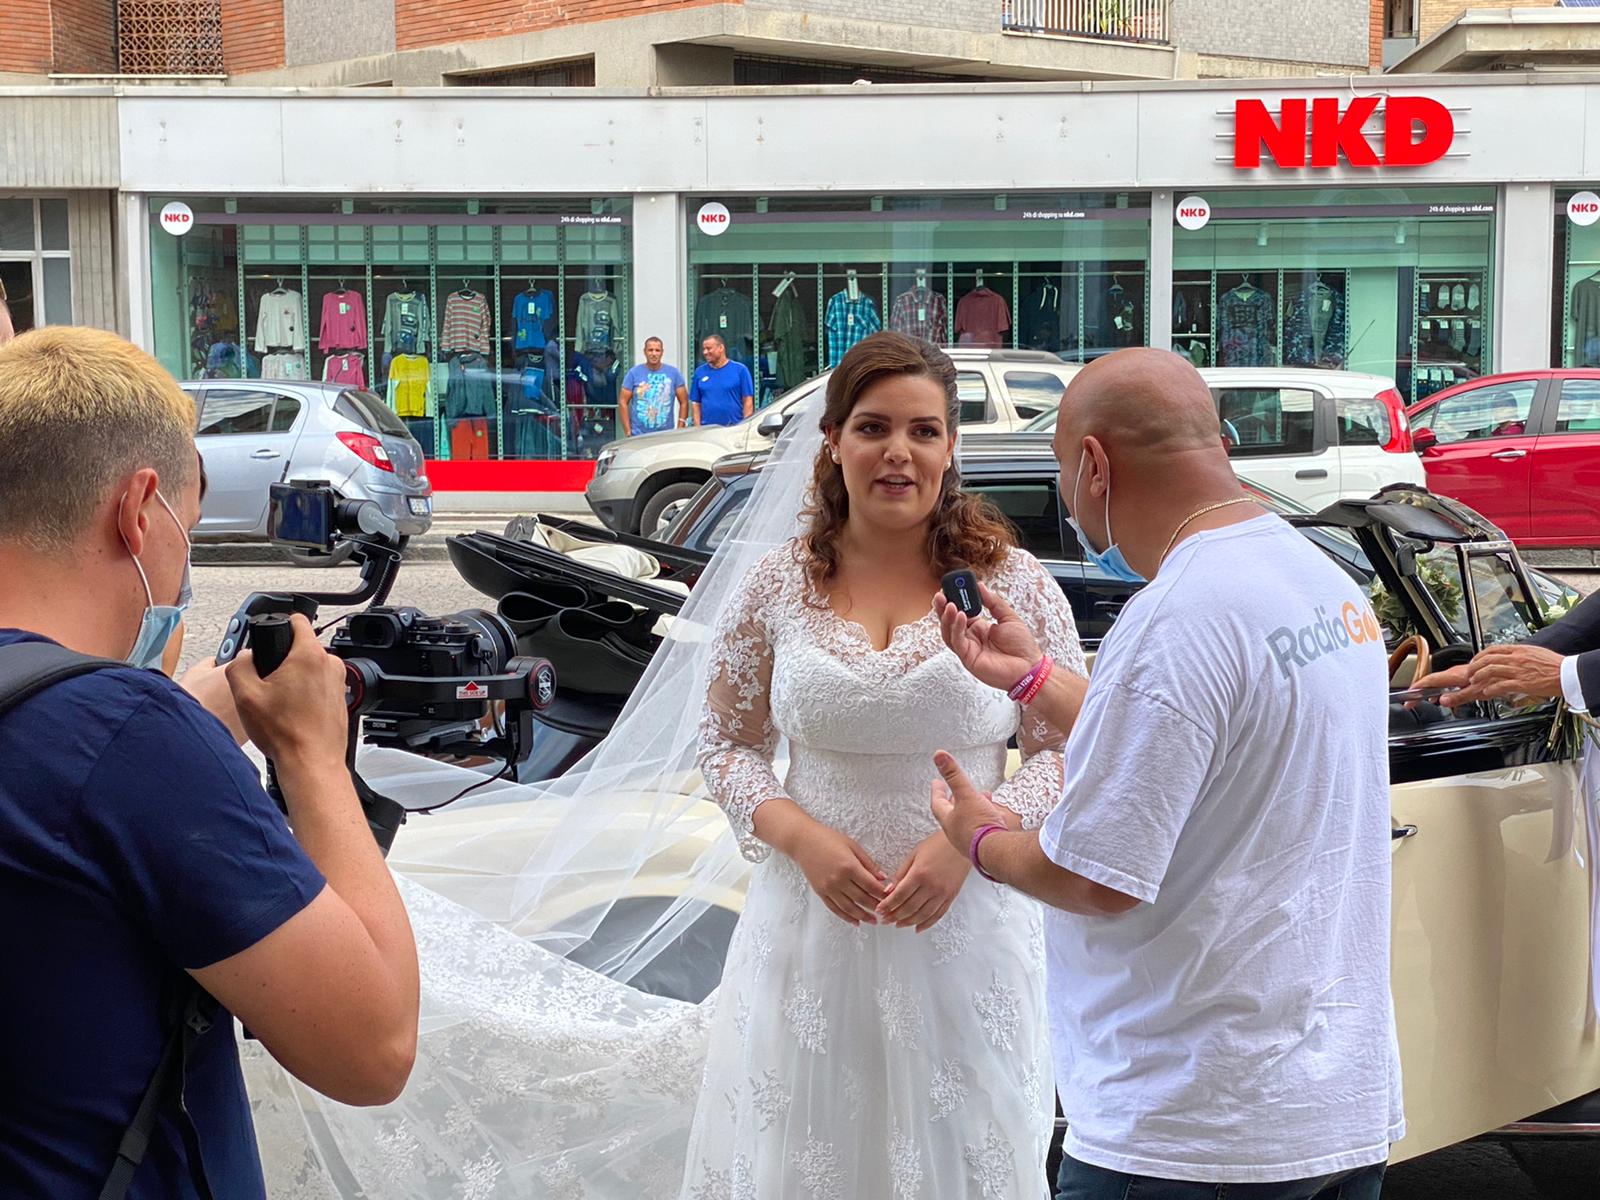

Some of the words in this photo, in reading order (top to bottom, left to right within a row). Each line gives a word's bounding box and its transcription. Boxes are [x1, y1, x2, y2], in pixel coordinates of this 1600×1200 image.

[1234, 96, 1454, 168] NKD
[1180, 208, 1206, 217] NKD
[1571, 203, 1598, 213] NKD
[164, 213, 190, 223] NKD
[701, 213, 727, 223] NKD
